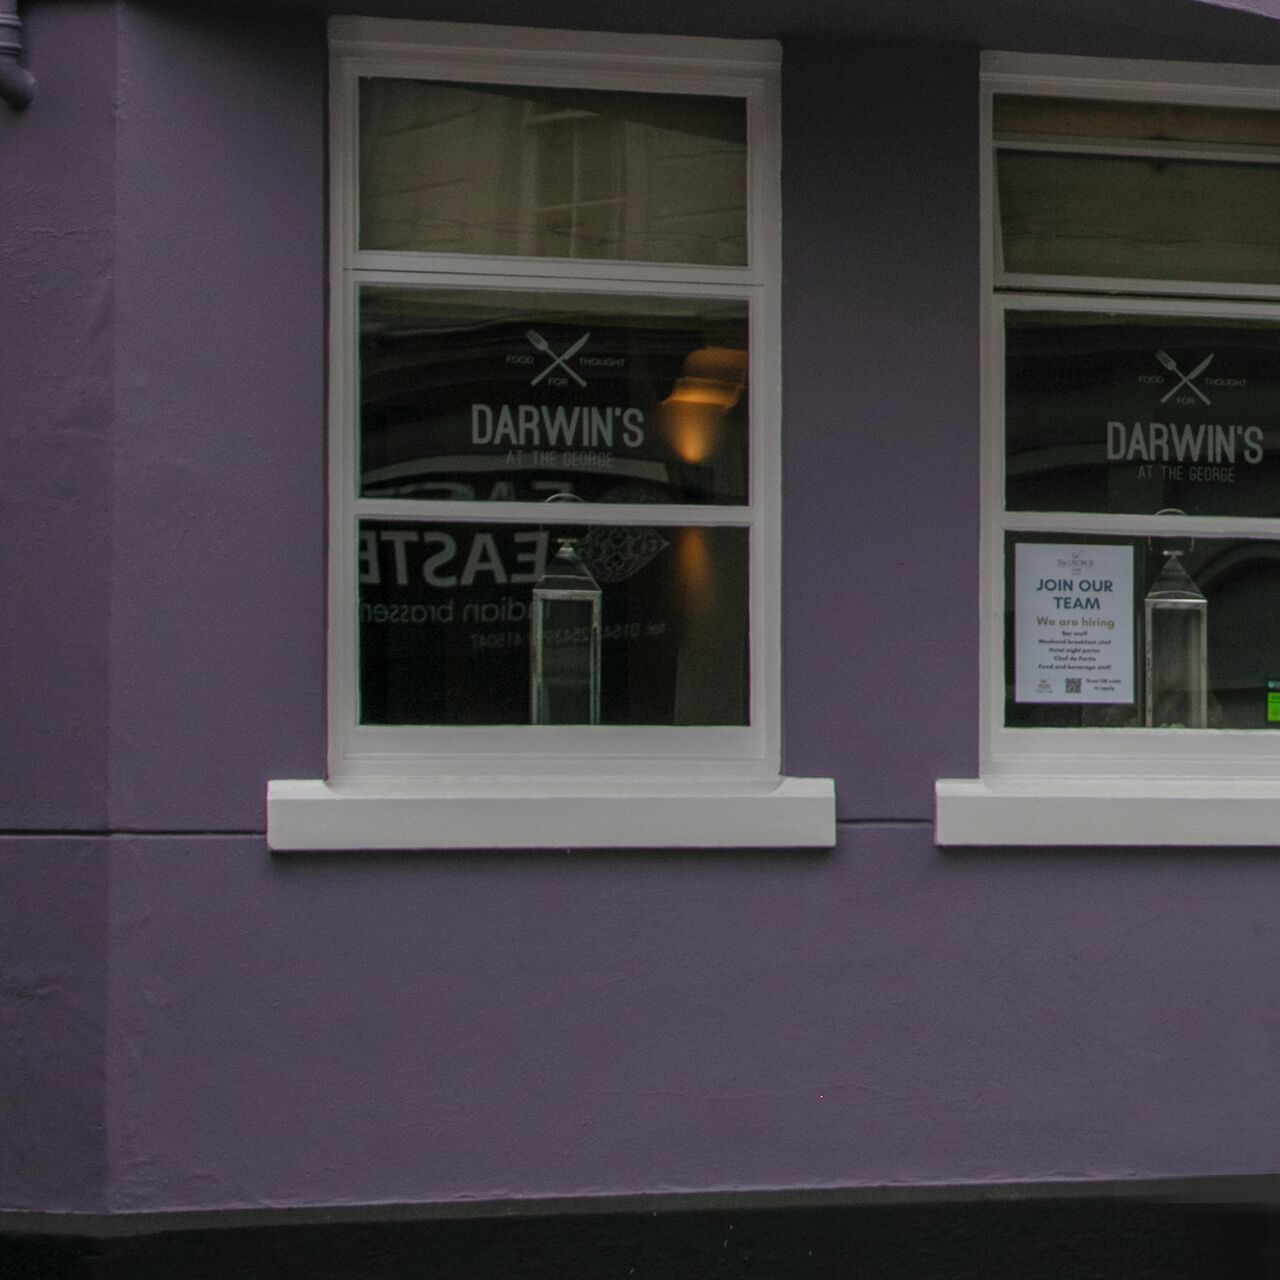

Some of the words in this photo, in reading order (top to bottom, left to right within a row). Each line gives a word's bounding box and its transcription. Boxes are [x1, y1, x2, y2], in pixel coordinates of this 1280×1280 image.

[506, 355, 534, 364] FOOD
[580, 357, 626, 367] THOUGHT
[548, 378, 569, 386] FOR
[1138, 376, 1164, 384] FOOD
[1205, 378, 1247, 386] THOUGHT
[472, 404, 645, 448] DARWIN'S
[1107, 421, 1264, 464] DARWIN'S
[506, 450, 523, 465] AT
[533, 450, 556, 466] THE
[563, 451, 614, 468] GEORGE
[1138, 465, 1152, 480] AT
[1162, 465, 1183, 481] THE
[1189, 466, 1235, 482] GEORGE
[1036, 579, 1073, 592] JOIN
[1079, 580, 1113, 592] OUR
[1053, 597, 1101, 609] TEAM
[1037, 616, 1056, 625] We
[1082, 617, 1115, 629] hiring
